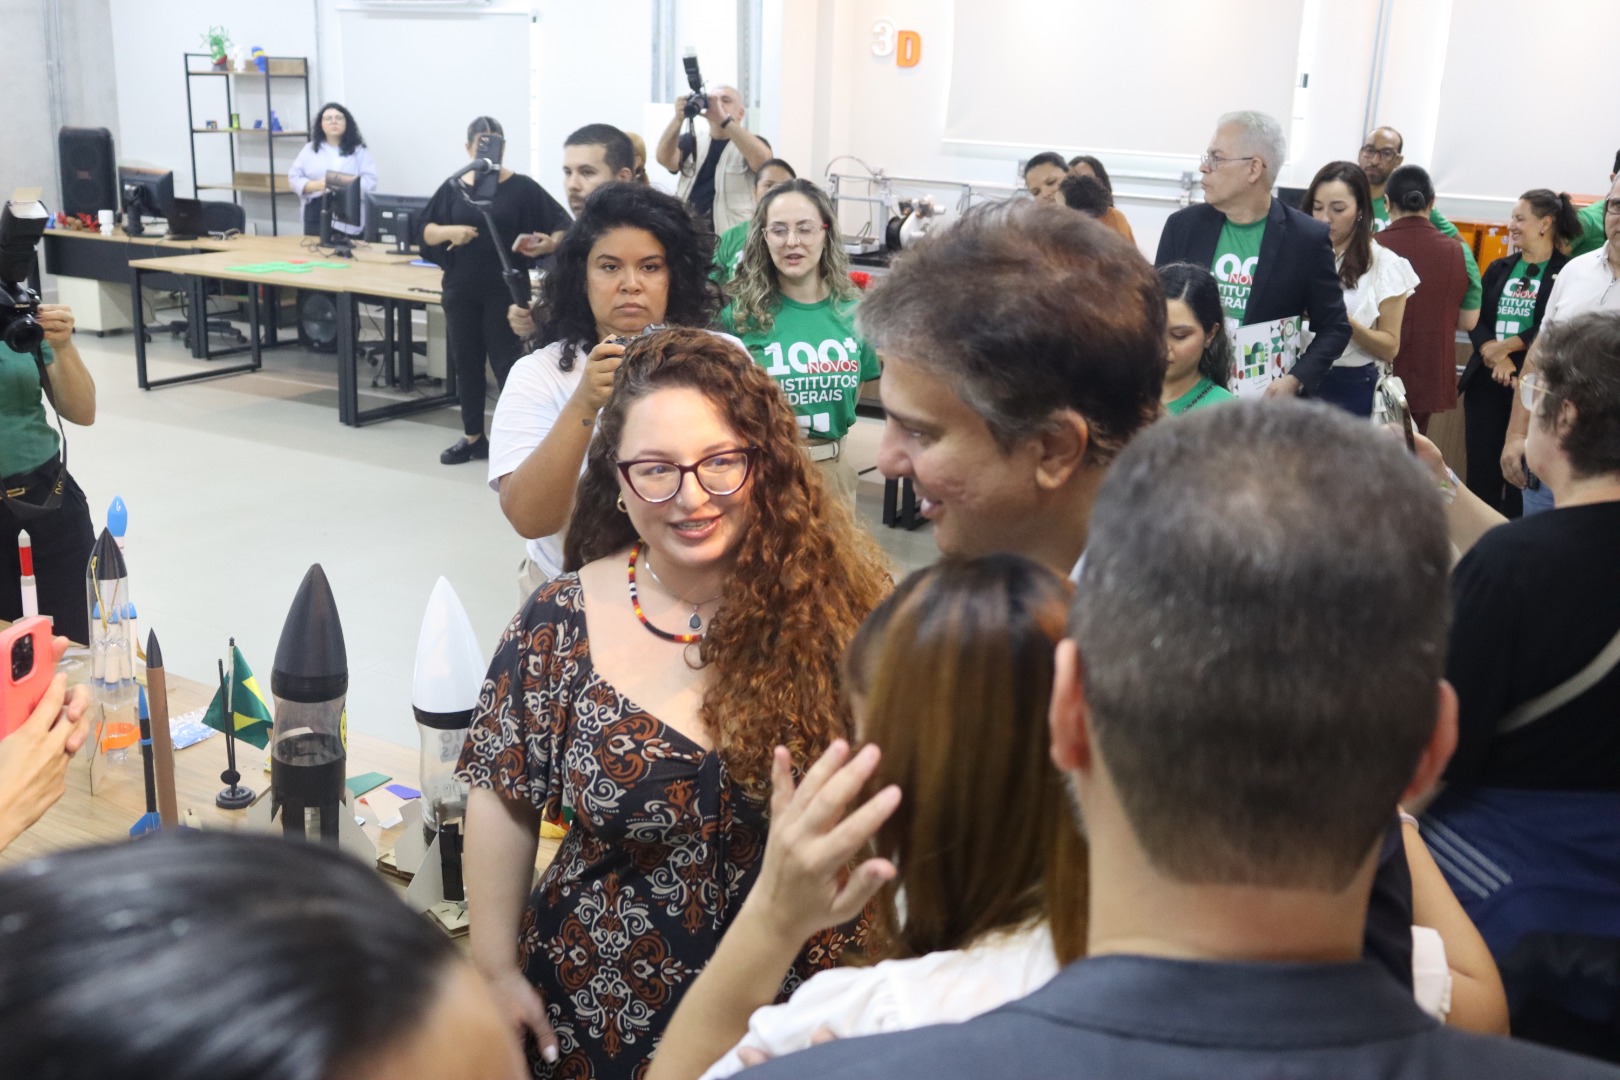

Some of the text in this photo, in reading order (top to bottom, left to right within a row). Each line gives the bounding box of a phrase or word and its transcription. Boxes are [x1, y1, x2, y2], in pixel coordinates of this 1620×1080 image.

[871, 19, 921, 67] 3D
[808, 360, 858, 374] NOVOS
[780, 375, 858, 392] STITUTOS
[785, 389, 843, 406] DERAIS
